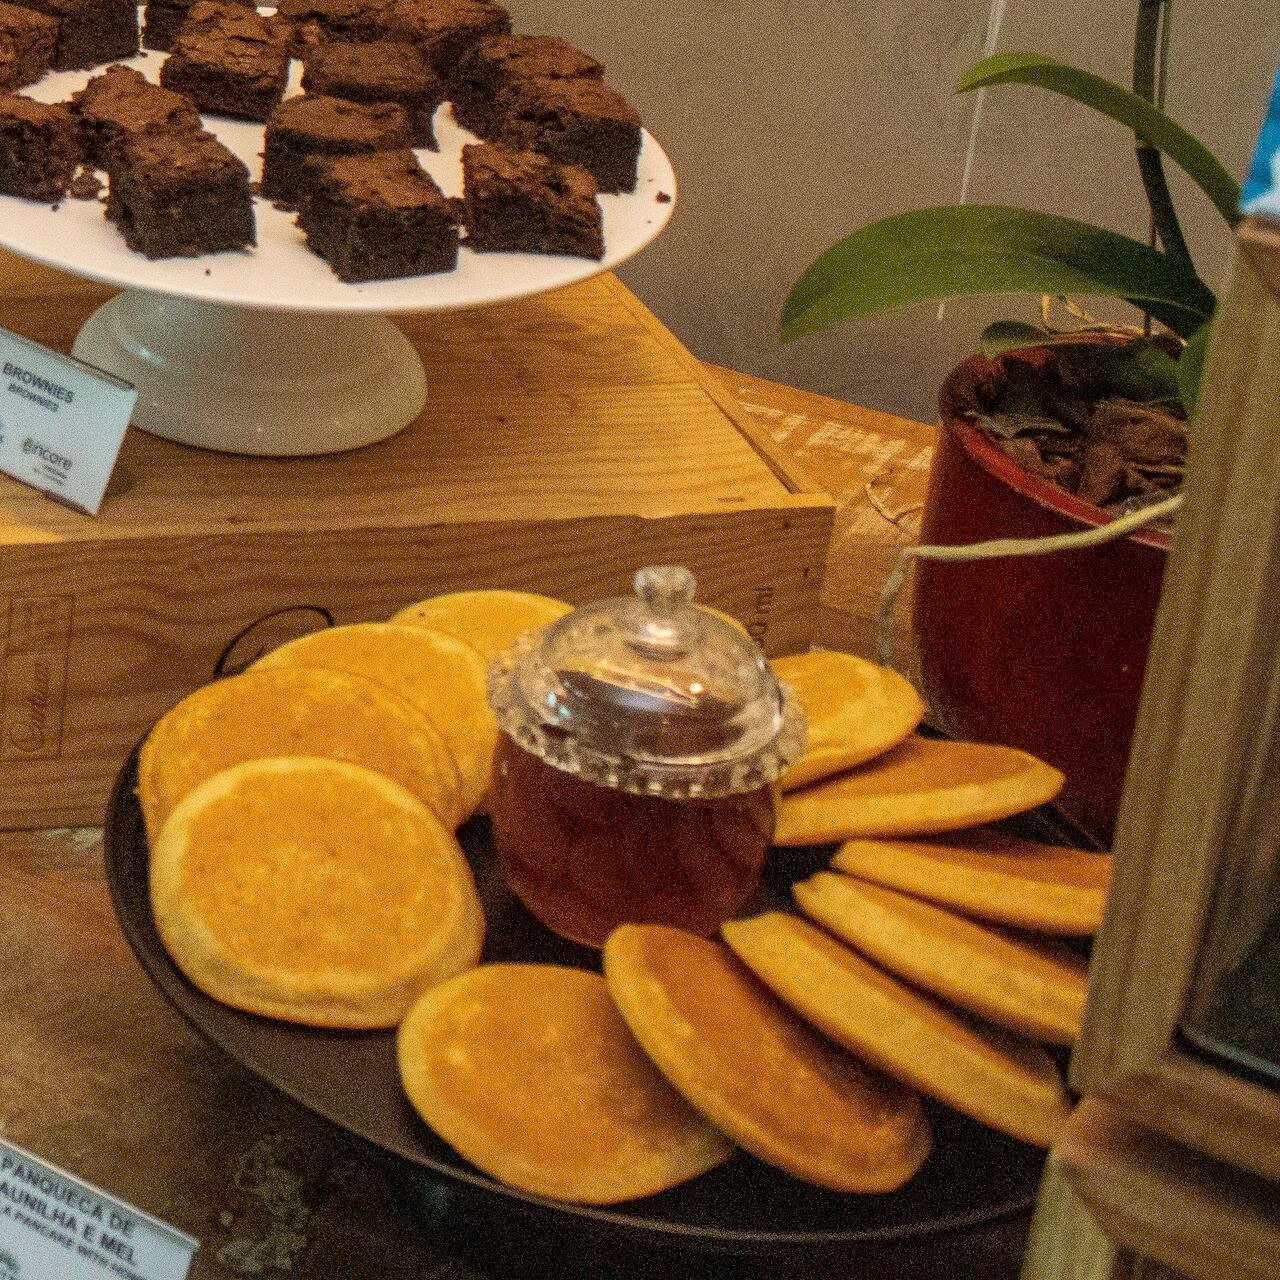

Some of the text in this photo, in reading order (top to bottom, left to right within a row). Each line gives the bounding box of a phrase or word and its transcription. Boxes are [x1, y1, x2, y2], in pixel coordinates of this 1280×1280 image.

[3, 362, 75, 405] BROWNIES
[8, 383, 60, 414] BROWNIES
[1, 1156, 138, 1238] PANQUECA DE
[13, 1211, 74, 1251] PANCAKE
[76, 1244, 109, 1268] WITH
[82, 1223, 96, 1243] E
[98, 1233, 138, 1267] MEL
